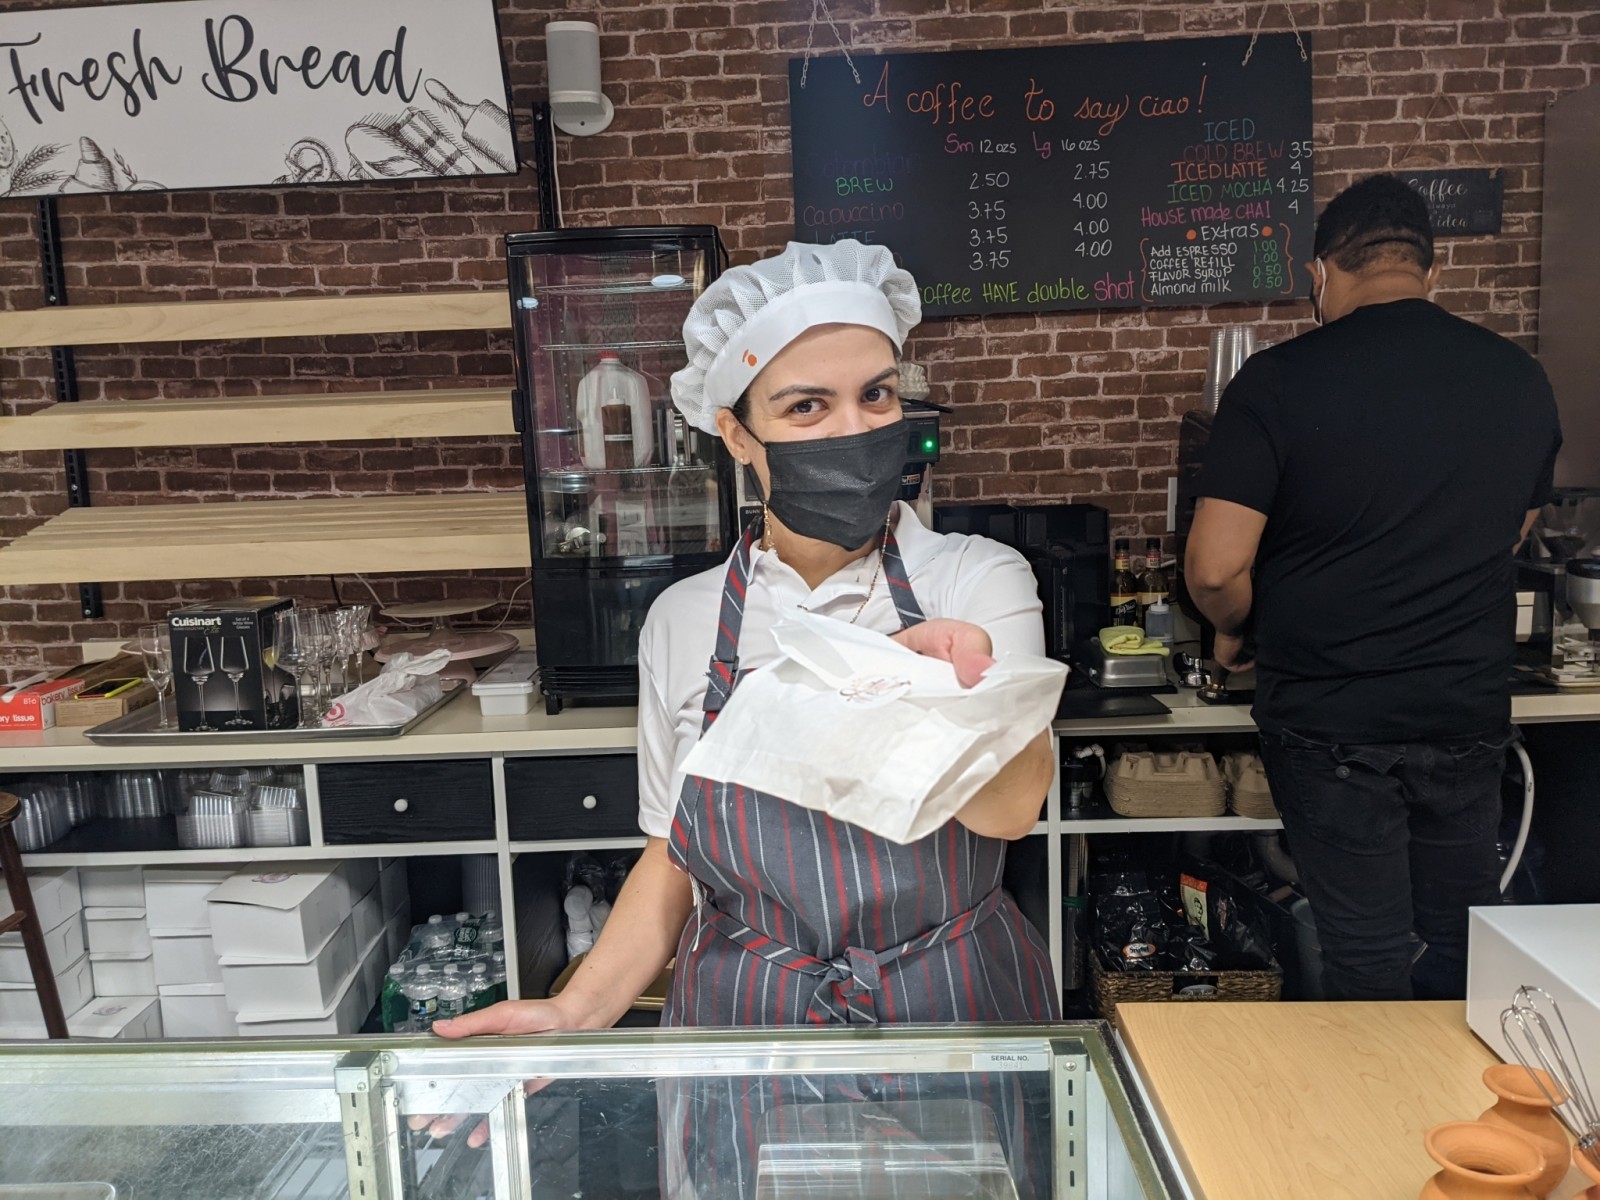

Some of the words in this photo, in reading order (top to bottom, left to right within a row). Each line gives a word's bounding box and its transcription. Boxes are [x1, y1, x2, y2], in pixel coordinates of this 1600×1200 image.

[0, 28, 182, 124] Fresh
[202, 15, 422, 102] Bread
[864, 61, 891, 113] A
[907, 82, 995, 125] coffee
[1024, 78, 1055, 121] to
[1074, 94, 1130, 137] say
[1203, 118, 1255, 142] ICED
[1032, 131, 1052, 159] Lg
[1183, 143, 1228, 163] COLD
[1232, 139, 1286, 162] BREW
[968, 171, 1011, 190] 2.50
[1074, 160, 1111, 180] 2.75
[1290, 160, 1302, 176] 4
[835, 176, 894, 196] BREW
[1167, 182, 1212, 203] ICED
[1220, 178, 1273, 199] MOCHA
[1276, 177, 1310, 194] 4.25
[968, 200, 1007, 221] 3.75
[1072, 191, 1109, 210] 4.00
[1190, 203, 1231, 222] made
[1235, 200, 1272, 220] CHAI
[1287, 198, 1300, 215] 4
[969, 227, 1009, 248] 3.75
[1073, 217, 1110, 237] 4.00
[1201, 222, 1260, 242] Extras
[969, 250, 1012, 271] 3.75
[1074, 238, 1113, 258] 4.00
[1150, 245, 1171, 258] Add
[1254, 240, 1278, 253] 1.00
[1253, 251, 1279, 266] 1.00
[1148, 268, 1192, 283] FLAVOR
[1253, 263, 1282, 278] 0.50
[982, 280, 1021, 304] HAVE
[1027, 276, 1090, 304] double
[1150, 281, 1196, 297] Almond
[1201, 278, 1232, 294] milk
[1252, 276, 1283, 290] 0.50
[171, 616, 223, 627] Cuisinart
[41, 690, 66, 706] bakery
[13, 714, 35, 722] tissue
